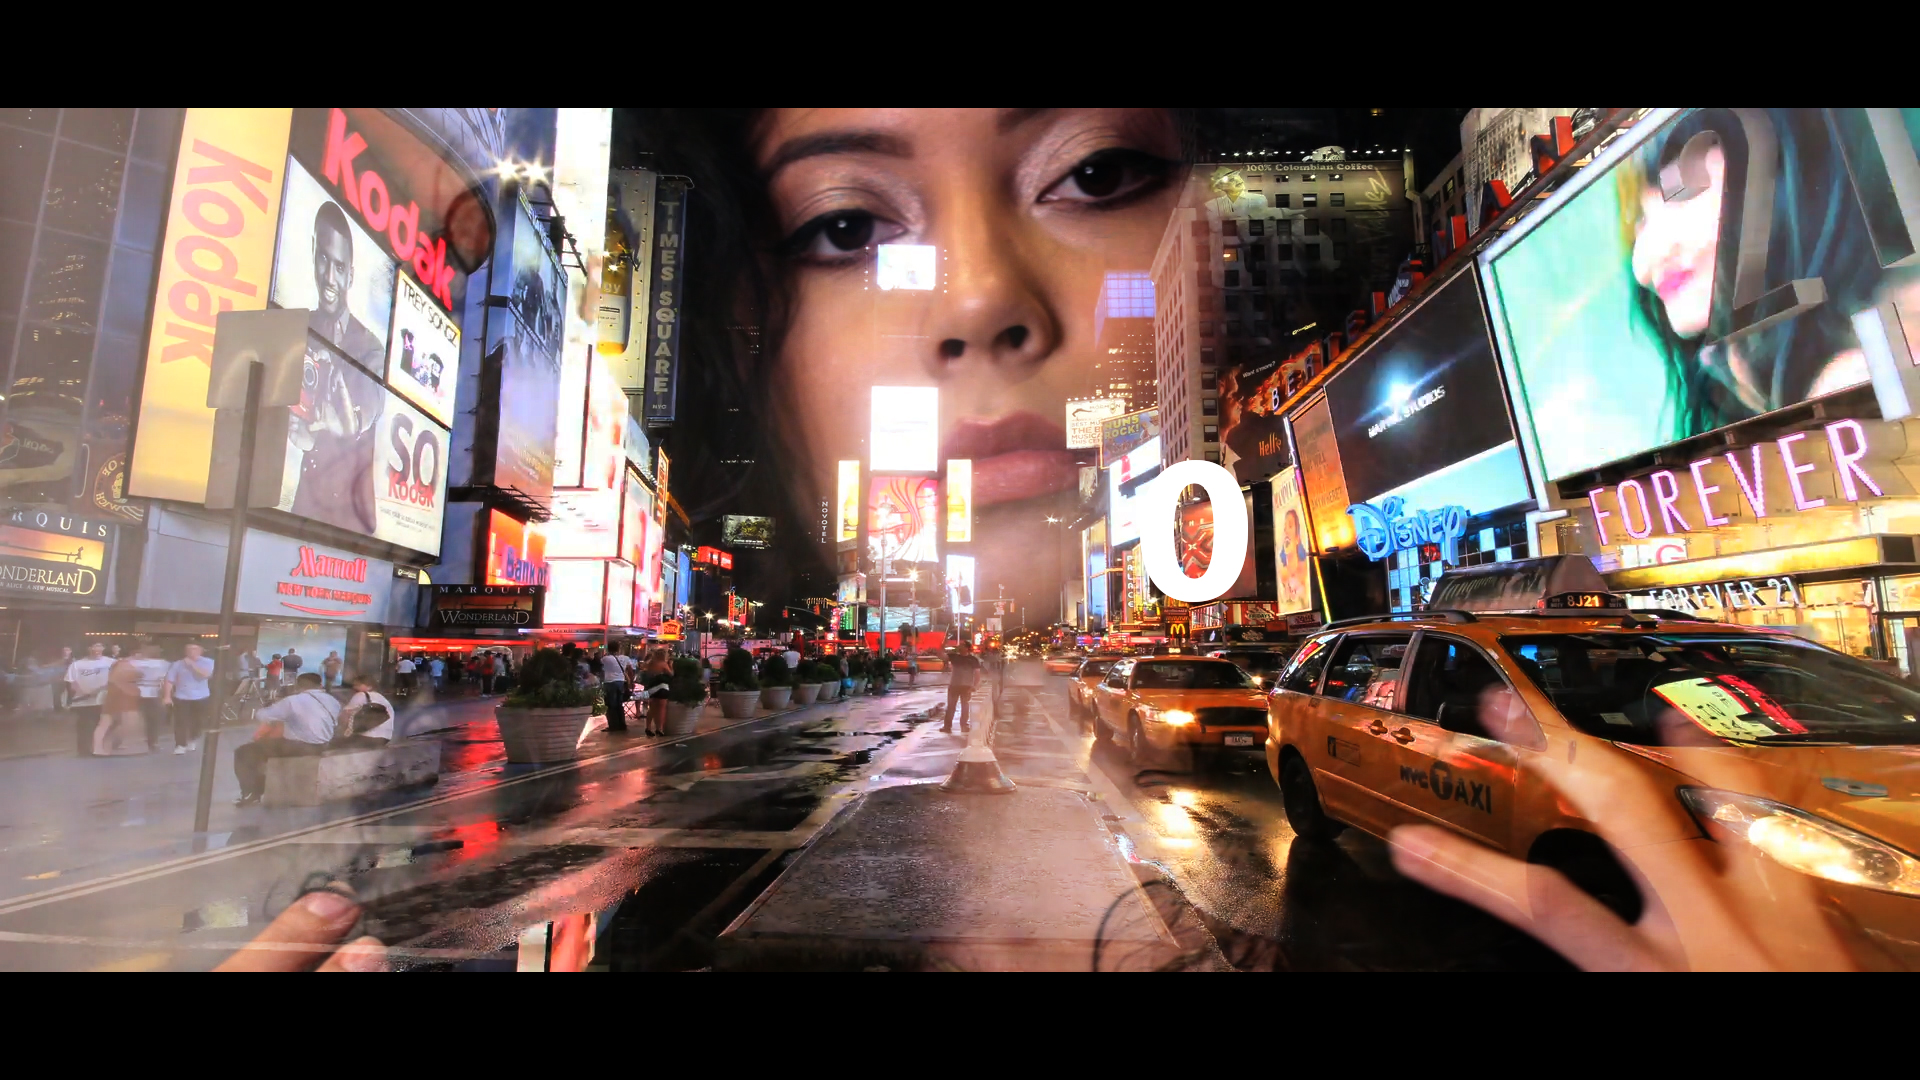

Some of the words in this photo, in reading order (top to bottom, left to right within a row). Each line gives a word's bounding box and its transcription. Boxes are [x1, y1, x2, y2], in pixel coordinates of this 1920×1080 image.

[1247, 164, 1272, 172] 100%
[1275, 163, 1334, 171] Colombian
[1337, 163, 1374, 171] Coffee
[324, 108, 452, 312] Kodak
[161, 138, 273, 365] Kodak
[659, 202, 679, 281] TIMES
[402, 278, 426, 314] TREY
[653, 291, 676, 393] SQUARE
[1070, 426, 1095, 435] THE
[387, 412, 440, 497] SO
[388, 470, 434, 509] Kodak
[1588, 418, 1885, 546] FOREVER
[0, 564, 97, 595] NDERLAND
[292, 545, 367, 583] Marriott
[506, 545, 535, 585] Bank
[276, 581, 304, 597] NEW
[439, 586, 536, 594] MARQUIS
[1567, 595, 1601, 607] 8J21
[1649, 580, 1766, 613] FOREVER
[1767, 576, 1801, 607] 21
[440, 610, 530, 625] WONDERLAND
